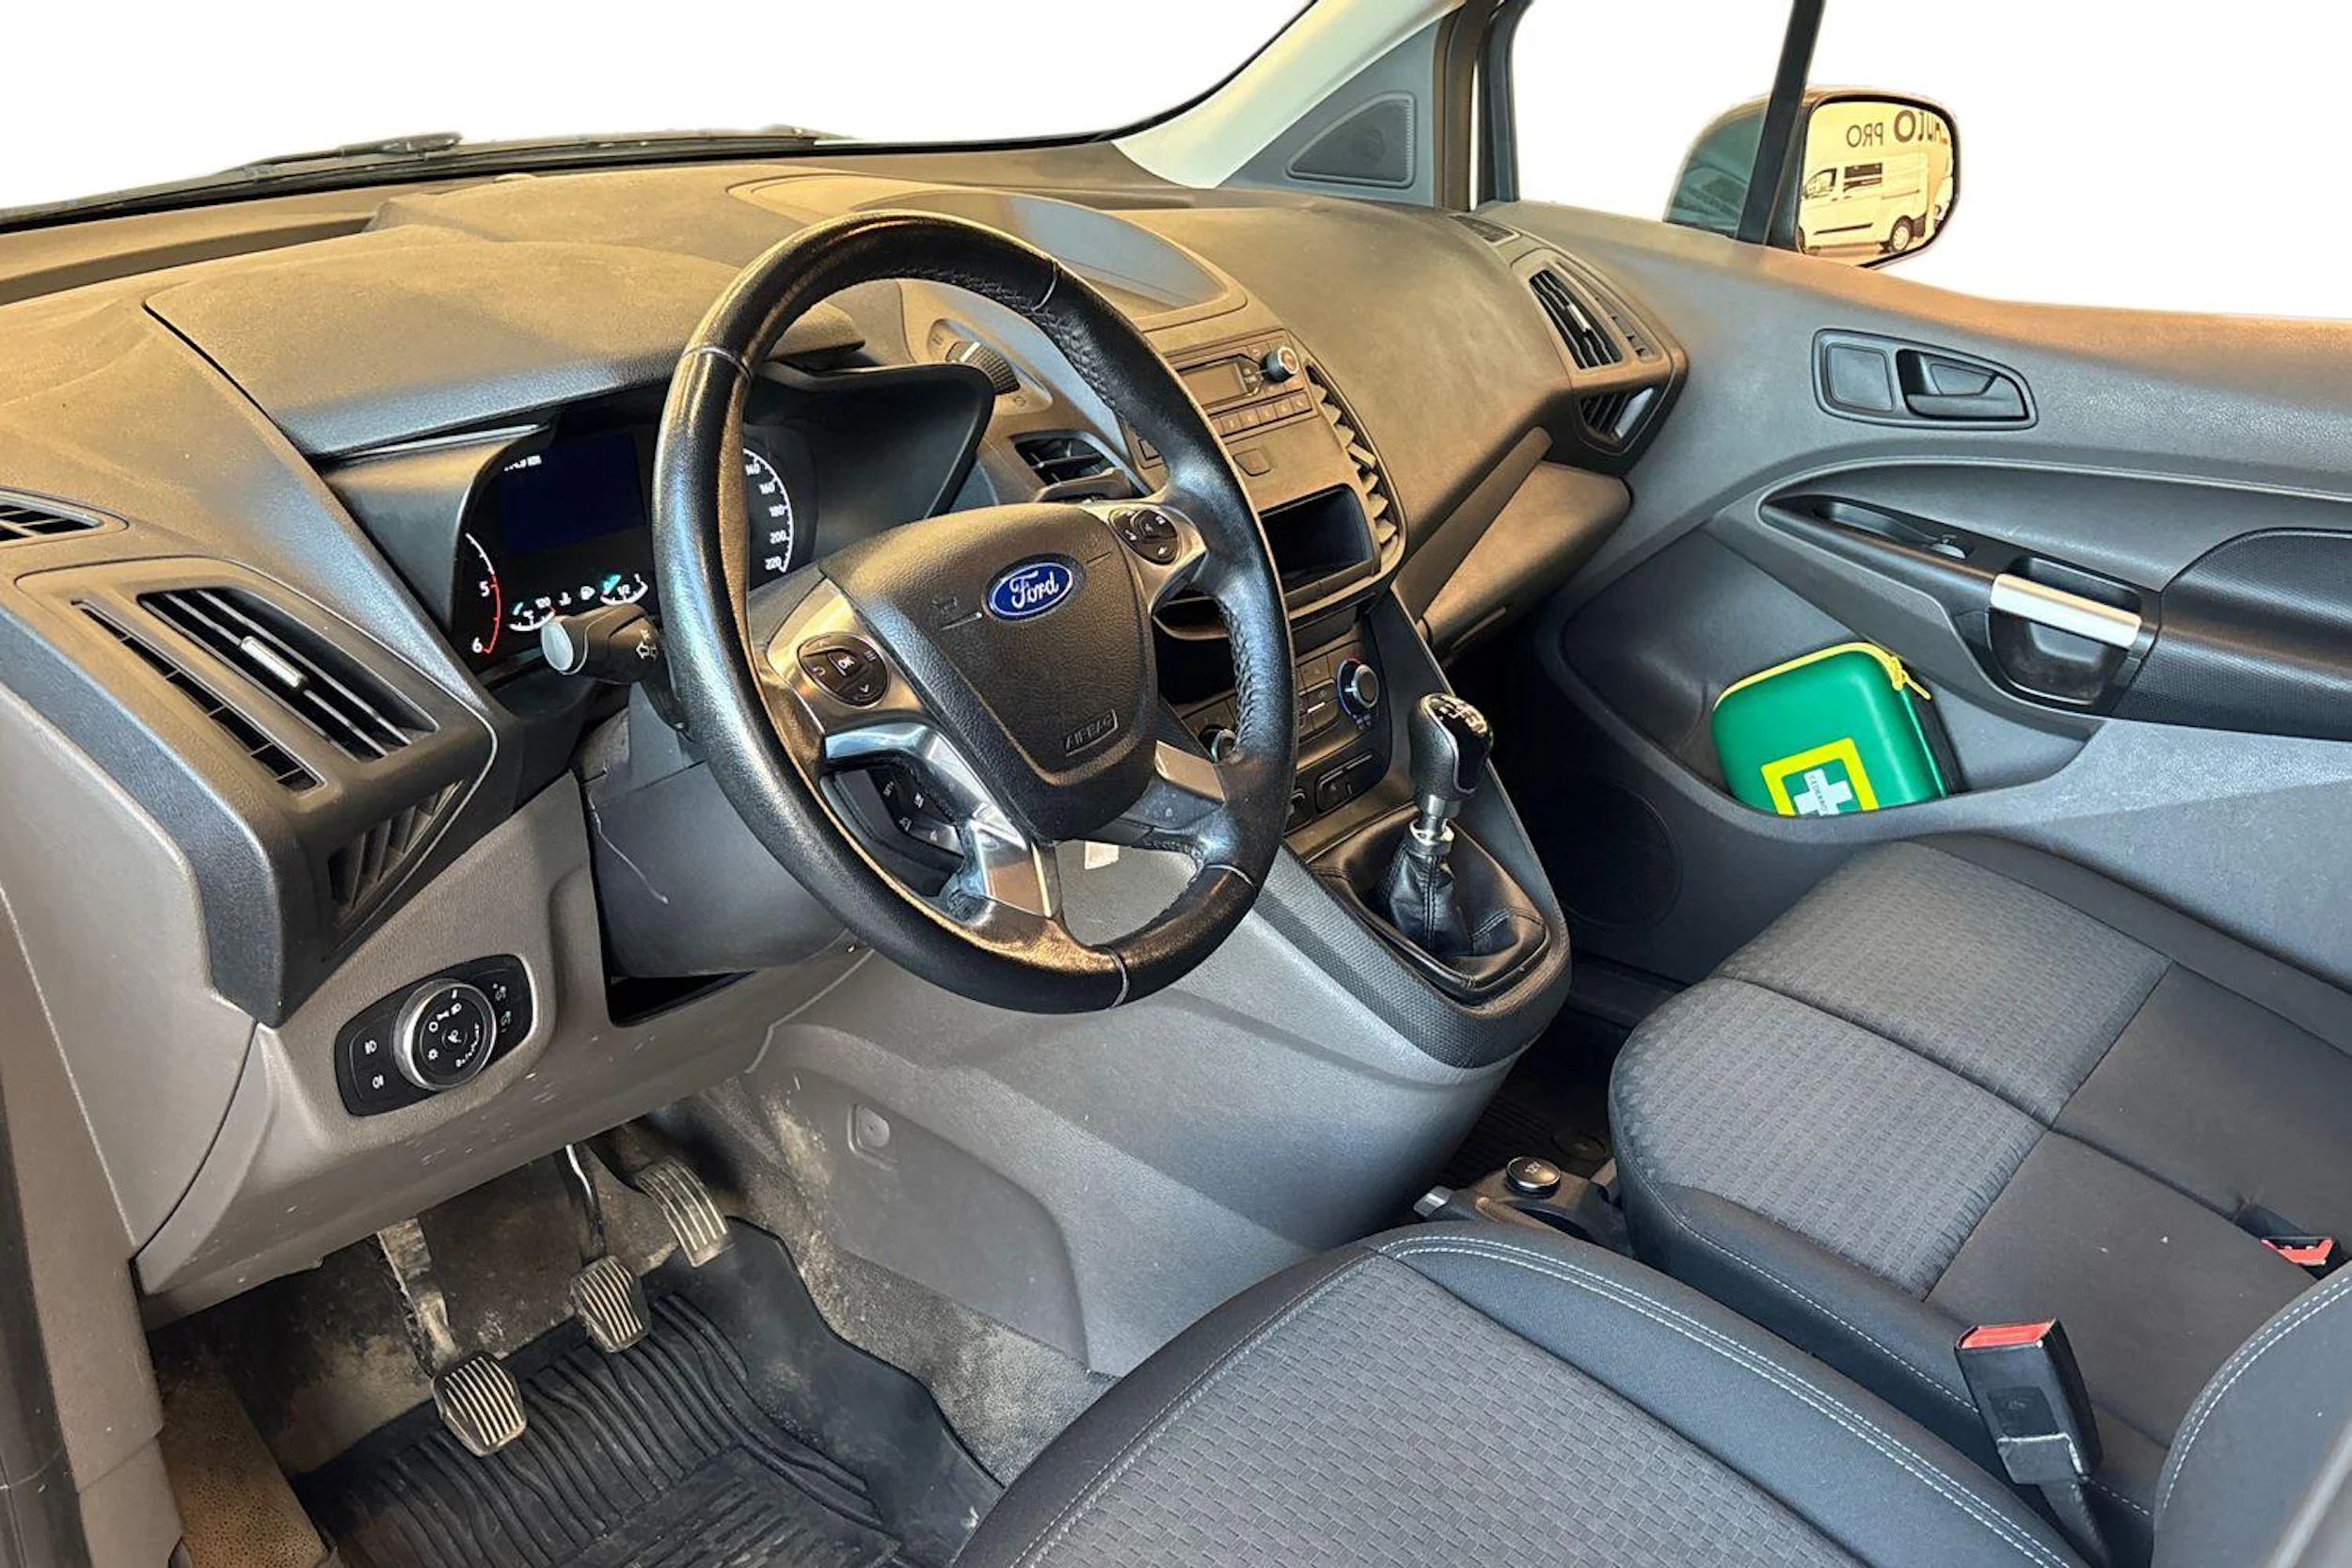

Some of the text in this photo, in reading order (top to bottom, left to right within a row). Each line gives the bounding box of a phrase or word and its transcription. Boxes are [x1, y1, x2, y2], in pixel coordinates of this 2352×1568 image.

[770, 530, 787, 544] 200
[479, 580, 490, 597] 5
[1009, 570, 1059, 609] Ford
[472, 637, 484, 654] 6
